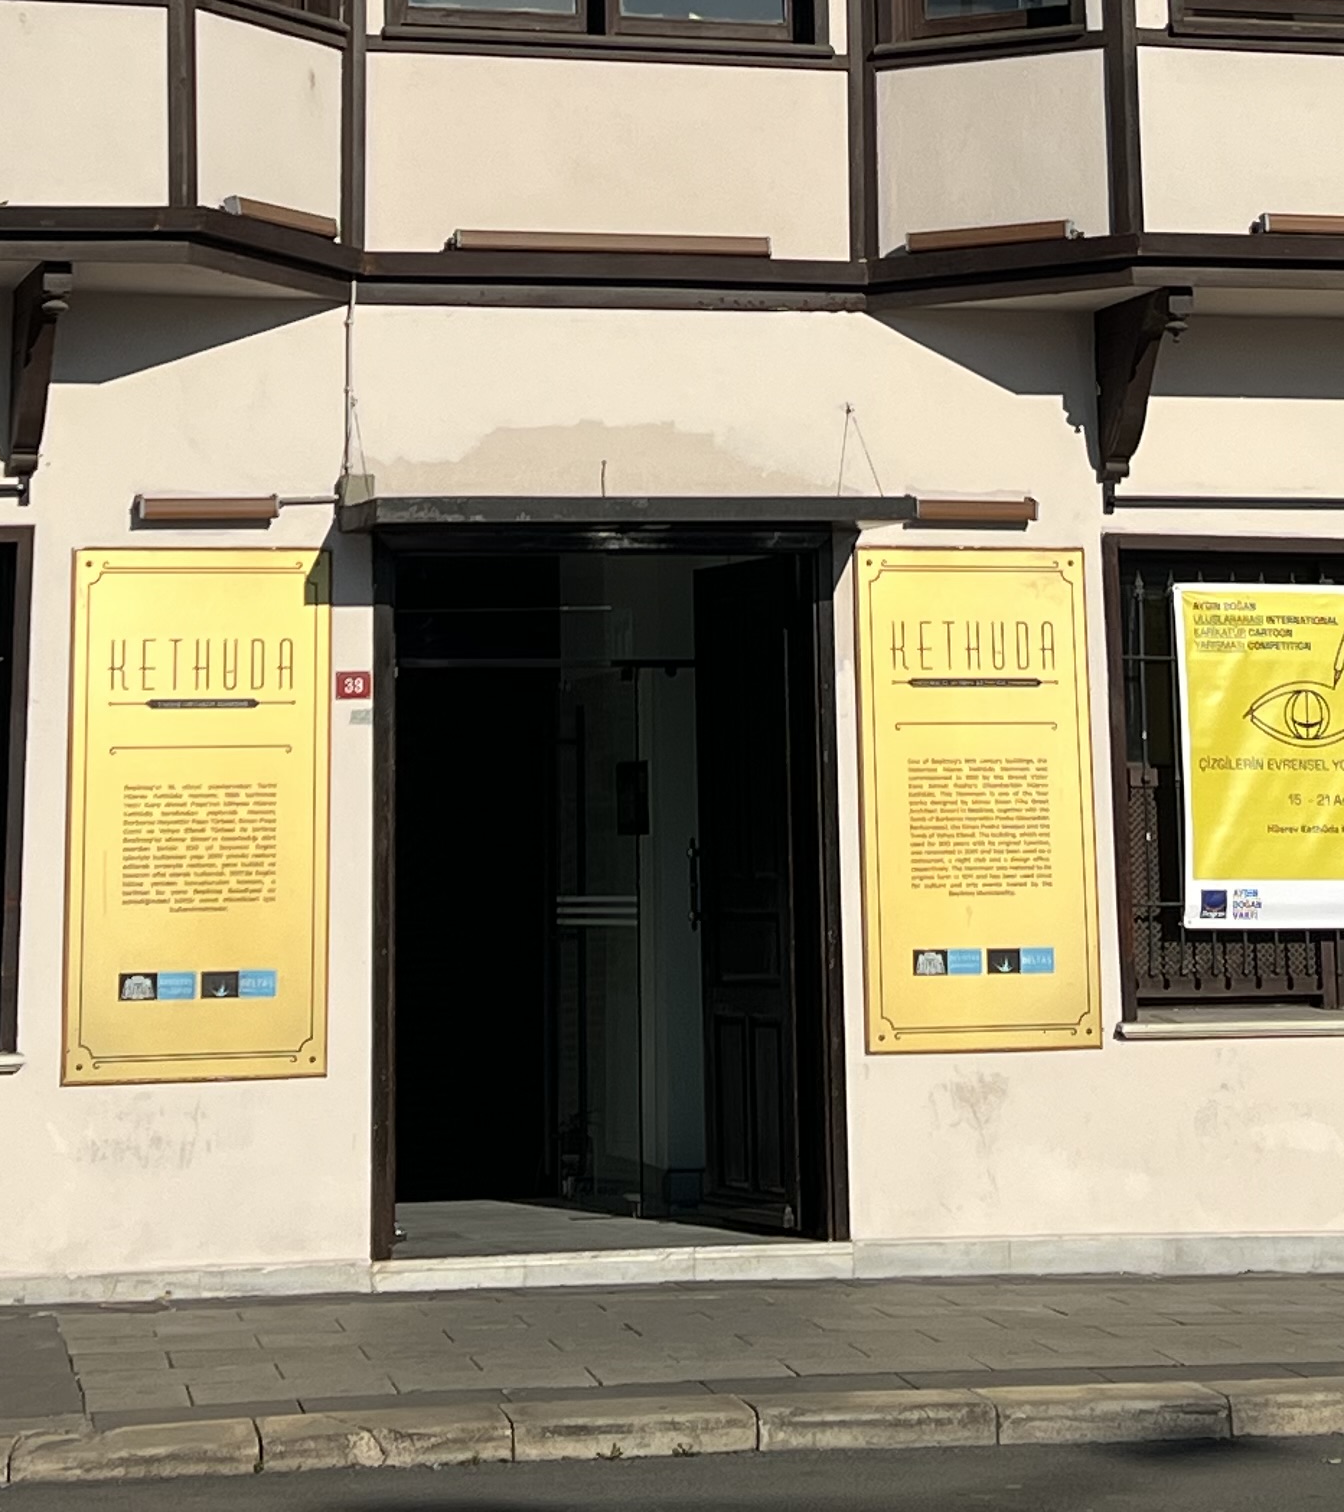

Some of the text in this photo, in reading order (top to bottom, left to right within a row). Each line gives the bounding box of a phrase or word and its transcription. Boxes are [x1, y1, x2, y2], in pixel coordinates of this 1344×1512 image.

[1248, 628, 1293, 638] CARTOON
[1267, 758, 1329, 772] EVRENSEL
[1316, 793, 1331, 806] 21
